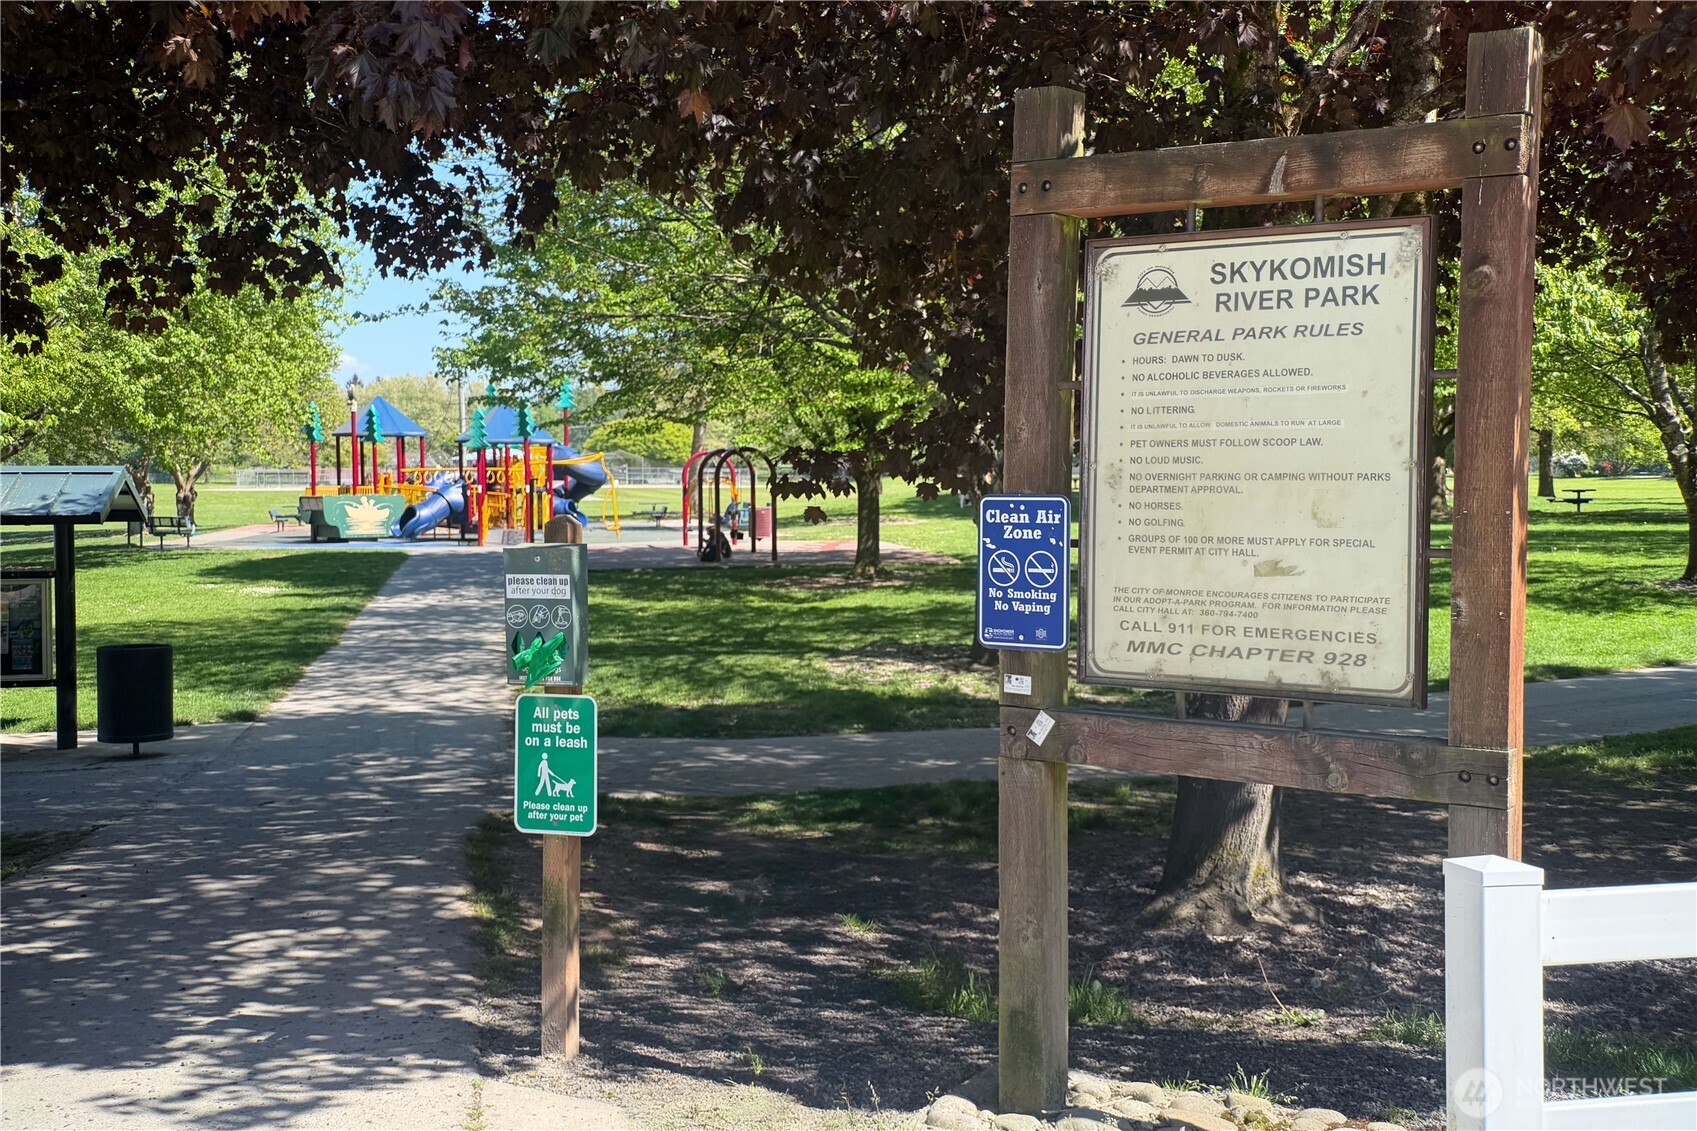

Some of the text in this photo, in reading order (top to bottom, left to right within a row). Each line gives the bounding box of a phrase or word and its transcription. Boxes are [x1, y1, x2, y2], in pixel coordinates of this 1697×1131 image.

[1210, 252, 1387, 285] SKYKOMISH
[1215, 284, 1380, 313] RIVER PARK
[1133, 322, 1364, 345] GENERAL PARK RULES
[1132, 353, 1245, 365] HOURS: DAWN TO DUSK.
[1147, 372, 1199, 381] ALCOHOLIC
[1203, 369, 1260, 379] BEVERAGES
[1263, 368, 1313, 377] ALLOWED.
[1192, 439, 1217, 447] MUST
[1220, 438, 1260, 447] FOLLOW
[1263, 438, 1296, 446] SCOOP
[1300, 438, 1323, 446] LAW.
[1261, 473, 1305, 481] CAMPING
[1309, 473, 1354, 481] WITHOUT
[1357, 473, 1391, 481] PARKS
[986, 509, 1061, 524] Clean Air
[1003, 526, 1042, 539] Zone
[1129, 535, 1166, 543] GROUPS
[1217, 537, 1244, 545] MORE
[1247, 537, 1274, 546] MUST
[1276, 538, 1306, 546] APPLY
[1310, 538, 1330, 547] FOR
[1332, 539, 1376, 548] SPECIAL
[1160, 547, 1194, 555] PERMIT
[1195, 547, 1205, 555] AT
[1208, 548, 1229, 556] CITY
[1232, 548, 1259, 557] HALL.
[508, 577, 568, 586] please clean up
[511, 586, 566, 597] after your dog
[989, 588, 1056, 602] No Smoking
[1206, 590, 1268, 599] ENCOURAGES
[1272, 593, 1312, 601] CITIZENS
[1330, 595, 1391, 604] PARTICIPATE
[994, 601, 1050, 615] No Vaping
[1143, 598, 1206, 606] ADOPT-A-PARK
[1209, 600, 1256, 609] PROGRAM.
[1283, 603, 1347, 613] INFORMATION
[1350, 606, 1388, 615] PLEASE
[1200, 609, 1258, 619] 360-794-7400
[1120, 620, 1162, 632] CALL
[1168, 622, 1193, 634] 911
[1202, 624, 1236, 636] FOR
[1127, 640, 1367, 666] MMC CHAPTER 928
[533, 707, 579, 721] All pets
[532, 722, 580, 734] must be
[525, 736, 587, 748] on a leash
[523, 801, 588, 814] Please clean up
[528, 811, 583, 822] after your pet
